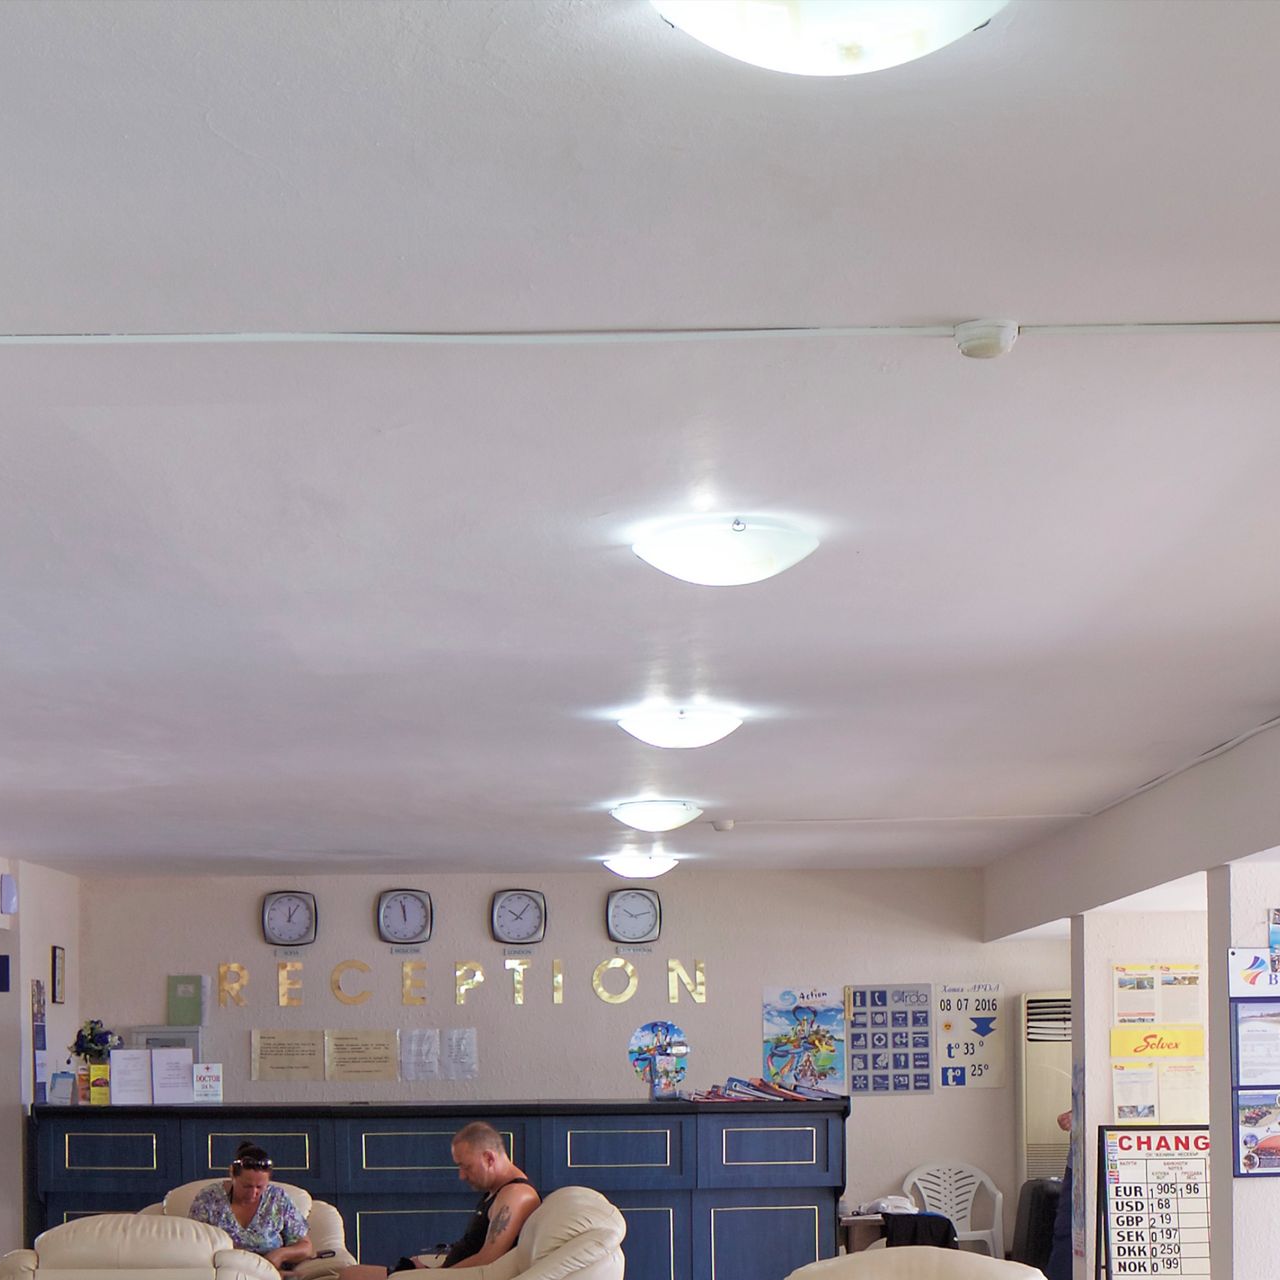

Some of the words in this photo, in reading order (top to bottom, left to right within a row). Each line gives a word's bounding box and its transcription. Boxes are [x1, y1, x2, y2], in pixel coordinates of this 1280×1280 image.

[218, 957, 706, 1008] RECEPTION
[799, 989, 828, 1001] Action
[940, 998, 952, 1012] 08
[956, 998, 969, 1012] 07
[975, 998, 998, 1012] 2016
[1118, 1135, 1210, 1151] CHANG
[1114, 1185, 1144, 1197] EUR
[1186, 1182, 1200, 1195] 96
[1115, 1200, 1145, 1212] USD
[1157, 1197, 1171, 1210] 68
[1115, 1215, 1144, 1227] GBP
[1160, 1212, 1172, 1225] 19
[1116, 1230, 1146, 1242] SEK
[1117, 1245, 1148, 1257] DKK
[1117, 1260, 1148, 1273] NOK
